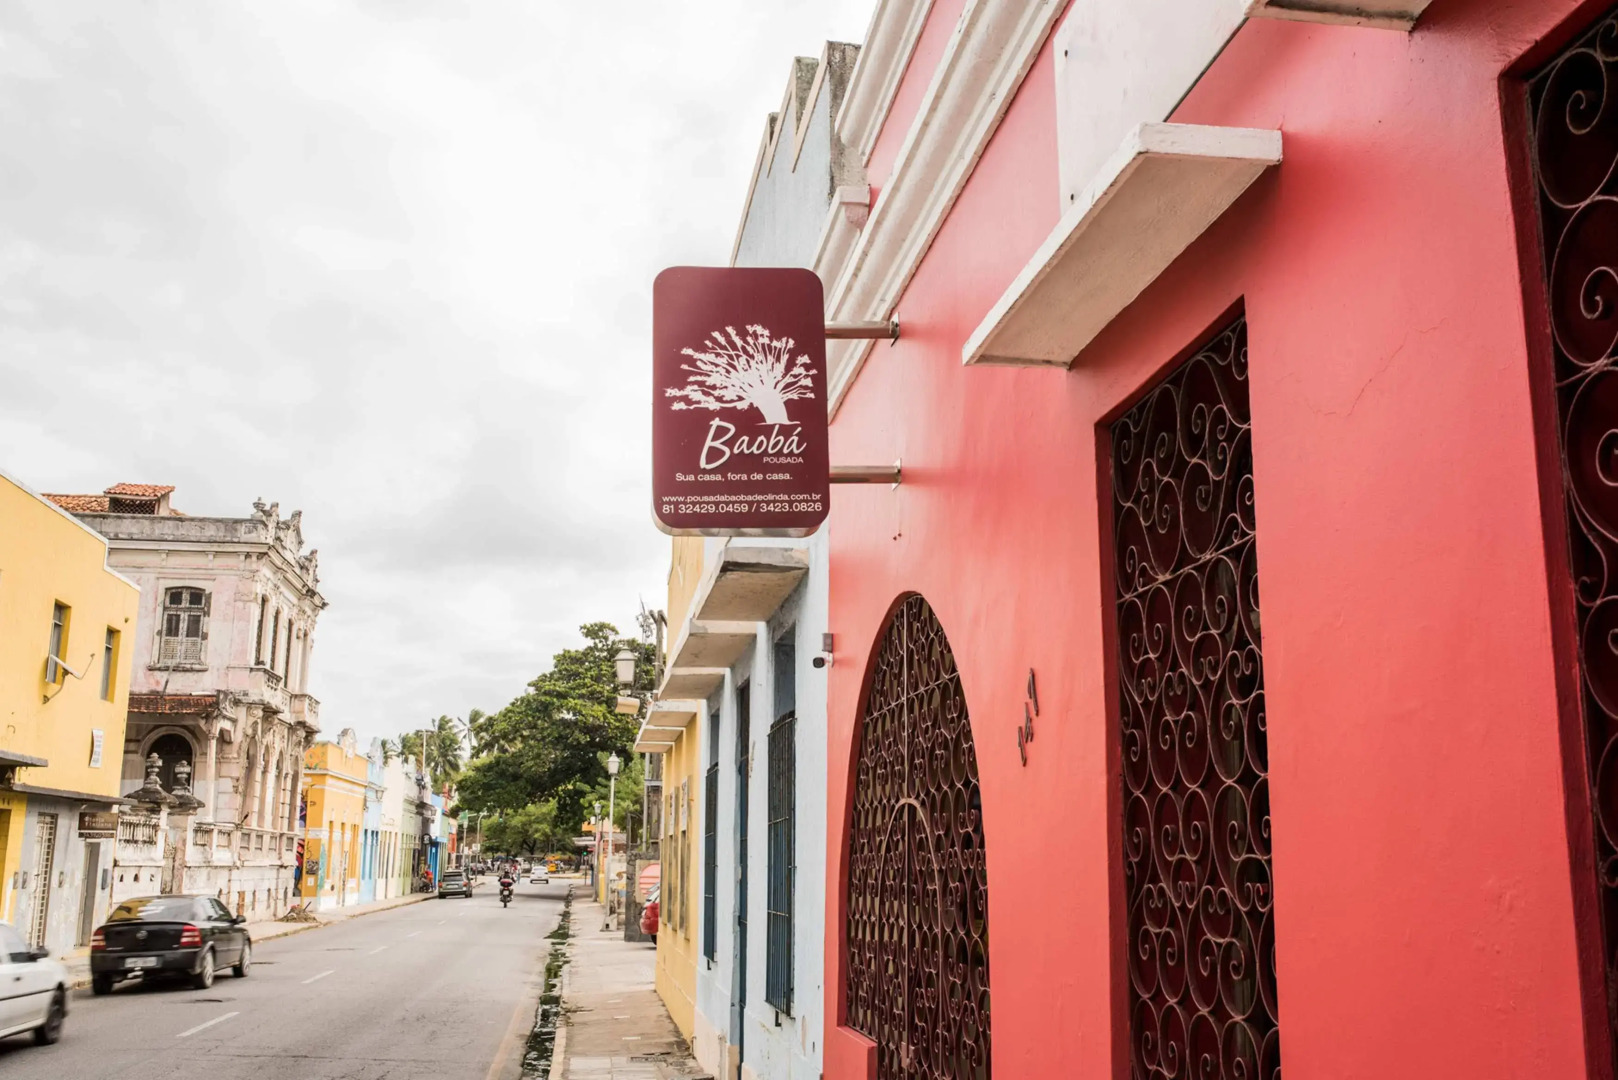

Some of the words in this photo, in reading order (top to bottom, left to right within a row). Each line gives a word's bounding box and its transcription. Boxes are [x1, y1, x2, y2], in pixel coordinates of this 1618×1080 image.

[699, 417, 807, 470] Baobá
[763, 456, 804, 464] POUSADA
[675, 472, 695, 482] Sua
[697, 473, 725, 482] casa,
[727, 472, 748, 481] fora
[750, 472, 763, 481] de
[765, 472, 793, 480] casa.
[662, 492, 822, 503] www.pousadabaobadeolinda.com.br
[662, 504, 675, 514] 81
[678, 503, 749, 514] 32429.0459
[751, 502, 757, 513] /
[759, 502, 823, 513] 3423.0826
